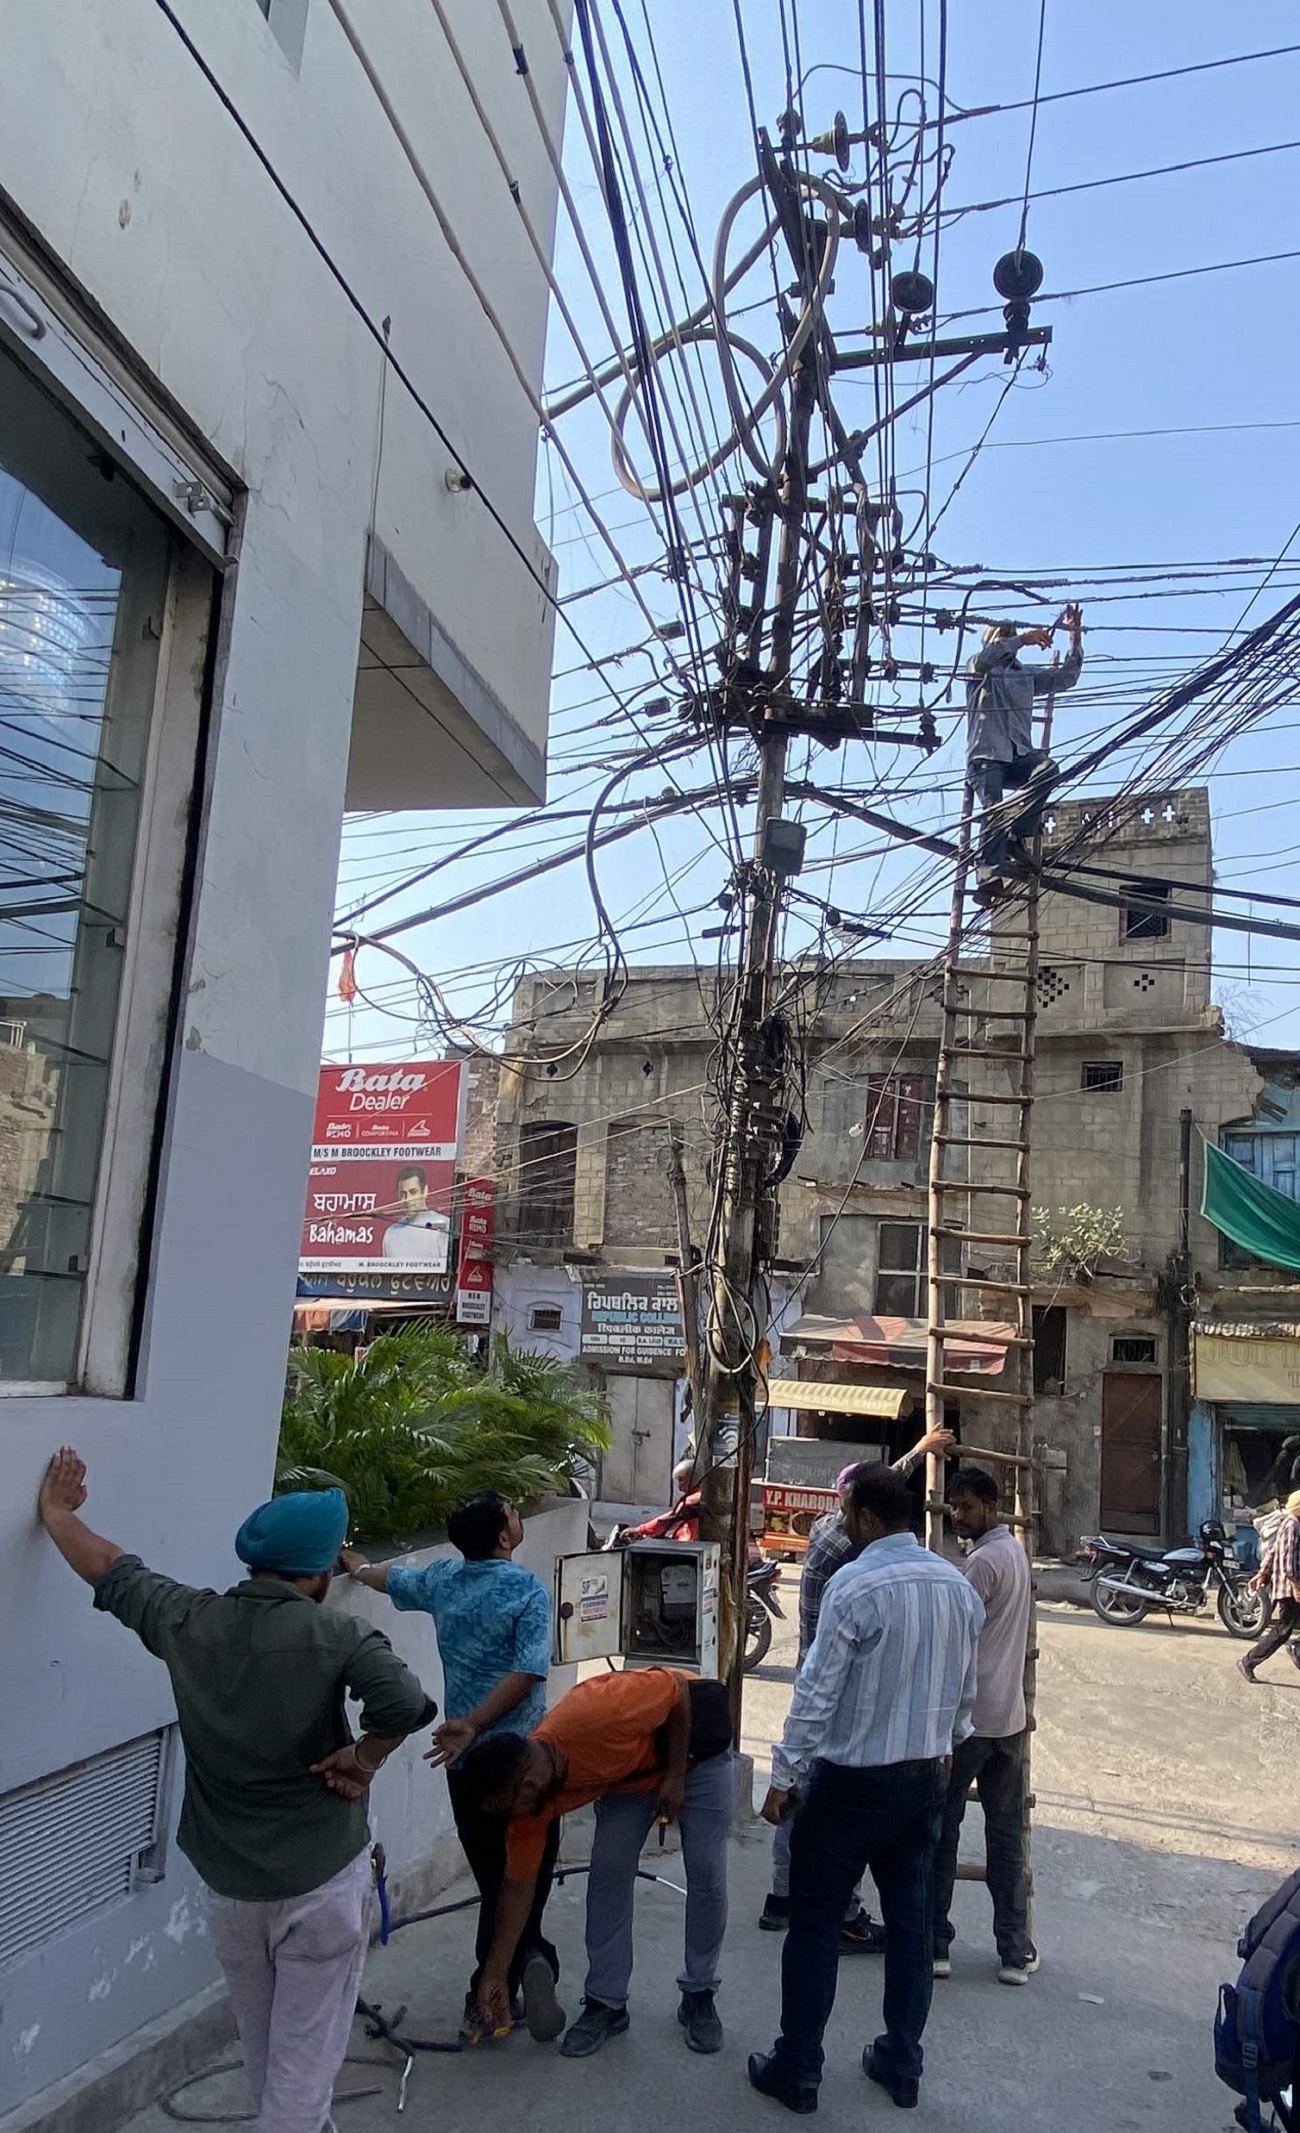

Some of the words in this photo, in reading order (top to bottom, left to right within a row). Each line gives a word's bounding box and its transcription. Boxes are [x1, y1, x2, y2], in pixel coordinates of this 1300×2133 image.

[335, 1068, 426, 1092] Bata
[350, 1092, 410, 1111] Dealer
[331, 1148, 338, 1157] M
[341, 1147, 391, 1157] BROOCKLEY
[394, 1146, 441, 1156] FOOTWEAR
[309, 1221, 374, 1244] Bahamas
[582, 1346, 620, 1354] ADMISSION
[622, 1347, 635, 1355] FOR
[637, 1348, 671, 1356] GUIDENCE
